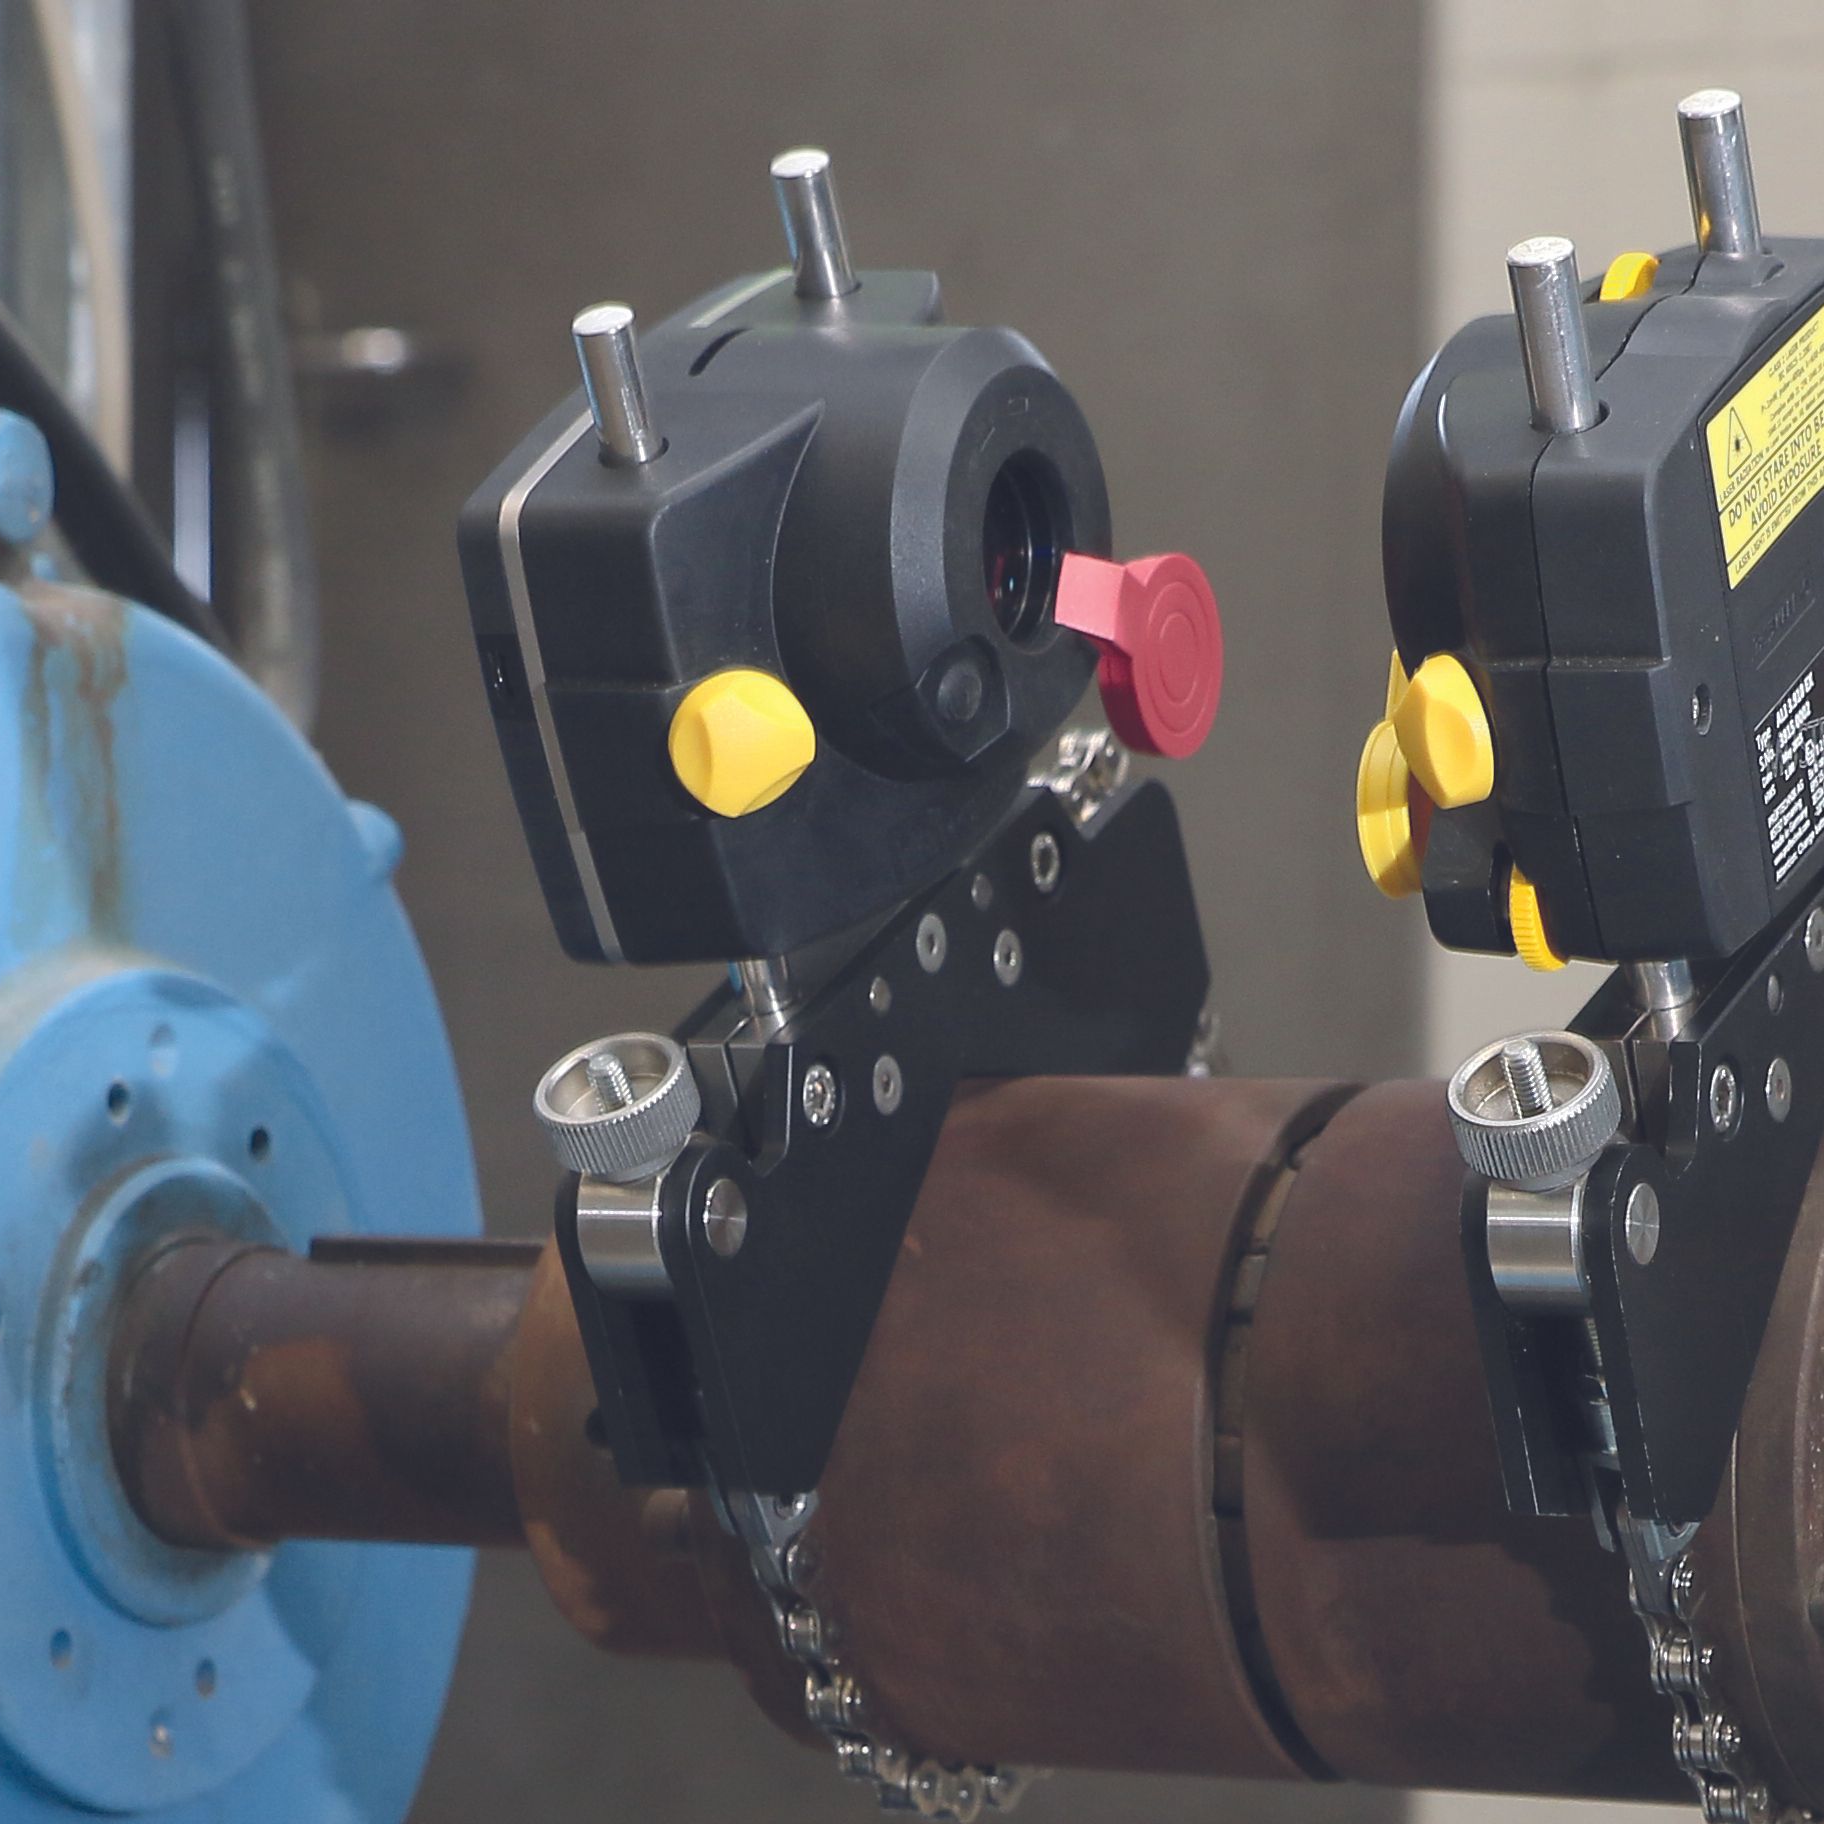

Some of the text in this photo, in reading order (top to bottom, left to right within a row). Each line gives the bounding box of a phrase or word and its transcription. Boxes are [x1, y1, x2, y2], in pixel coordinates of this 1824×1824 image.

[1718, 448, 1764, 505] LASER RADIATION
[1727, 498, 1743, 529] DO
[1742, 476, 1763, 512] NOT
[1762, 446, 1790, 490] STARE
[1789, 421, 1813, 459] INTO
[1749, 485, 1778, 531] AVOID
[1777, 436, 1822, 498] EXPOSURE
[1734, 548, 1751, 575] LASER
[1755, 727, 1772, 751] Type
